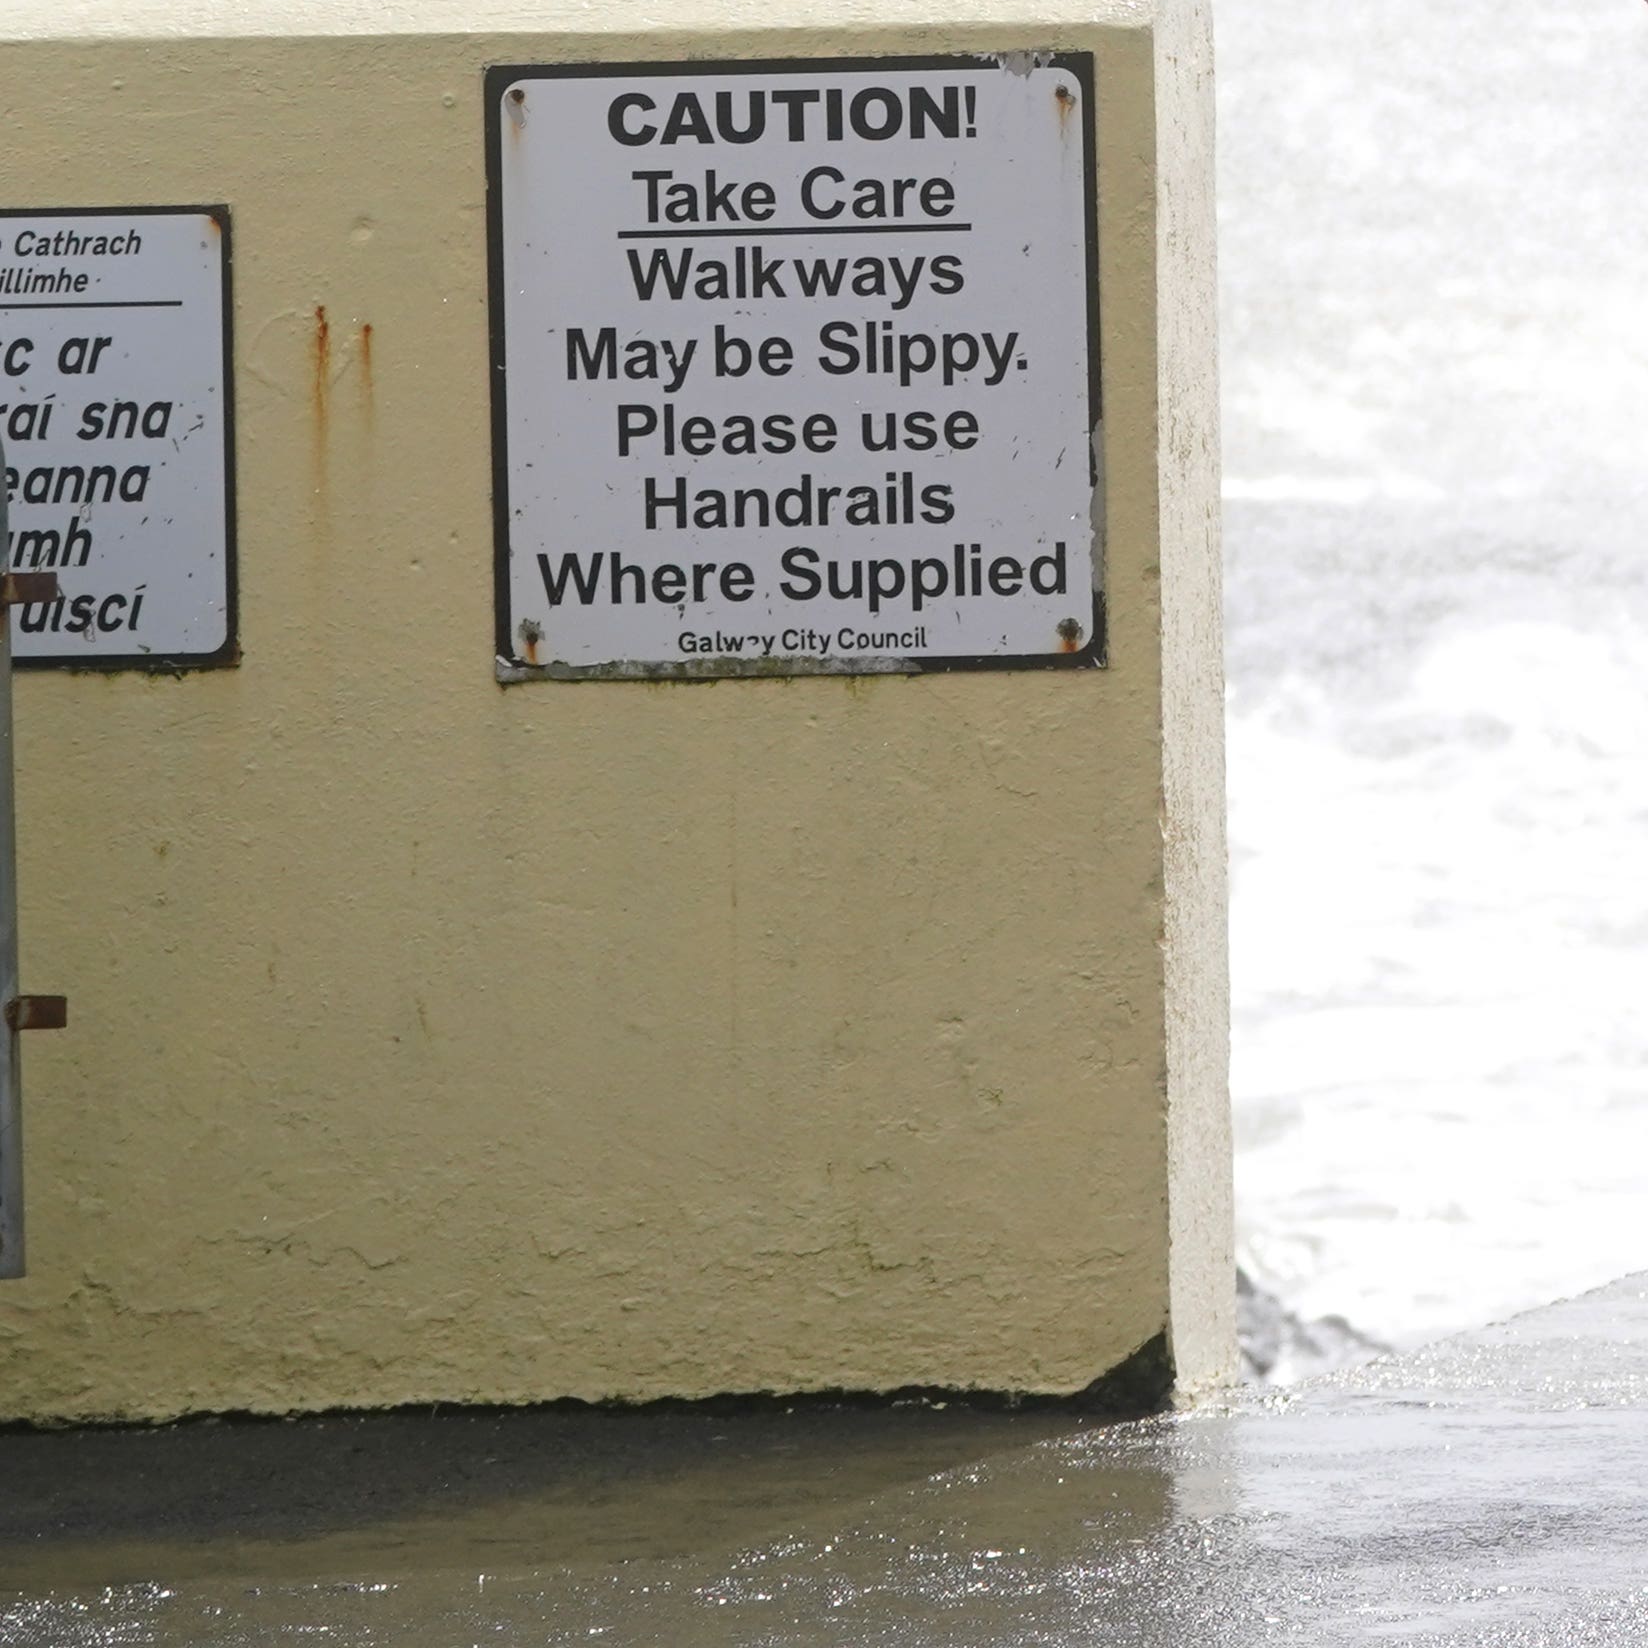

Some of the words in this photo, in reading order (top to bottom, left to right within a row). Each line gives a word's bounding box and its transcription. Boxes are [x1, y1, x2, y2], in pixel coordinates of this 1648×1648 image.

[608, 86, 976, 146] CAUTION!
[632, 169, 776, 223] Take
[801, 166, 955, 220] Care
[15, 229, 141, 257] Cathrach
[626, 246, 964, 313] Walkways
[0, 337, 34, 377] c
[58, 336, 113, 376] ar
[566, 327, 698, 393] May
[715, 324, 793, 377] be
[818, 321, 1027, 387] Slippy.
[77, 399, 173, 441] sna
[618, 404, 837, 457] Please
[862, 411, 979, 453] use
[6, 465, 150, 504] eanna
[645, 472, 955, 530] Handrails
[8, 516, 92, 568] mh
[536, 552, 755, 605] Where
[779, 542, 1066, 613] Supplied
[781, 627, 832, 655] City
[837, 626, 927, 650] Council
